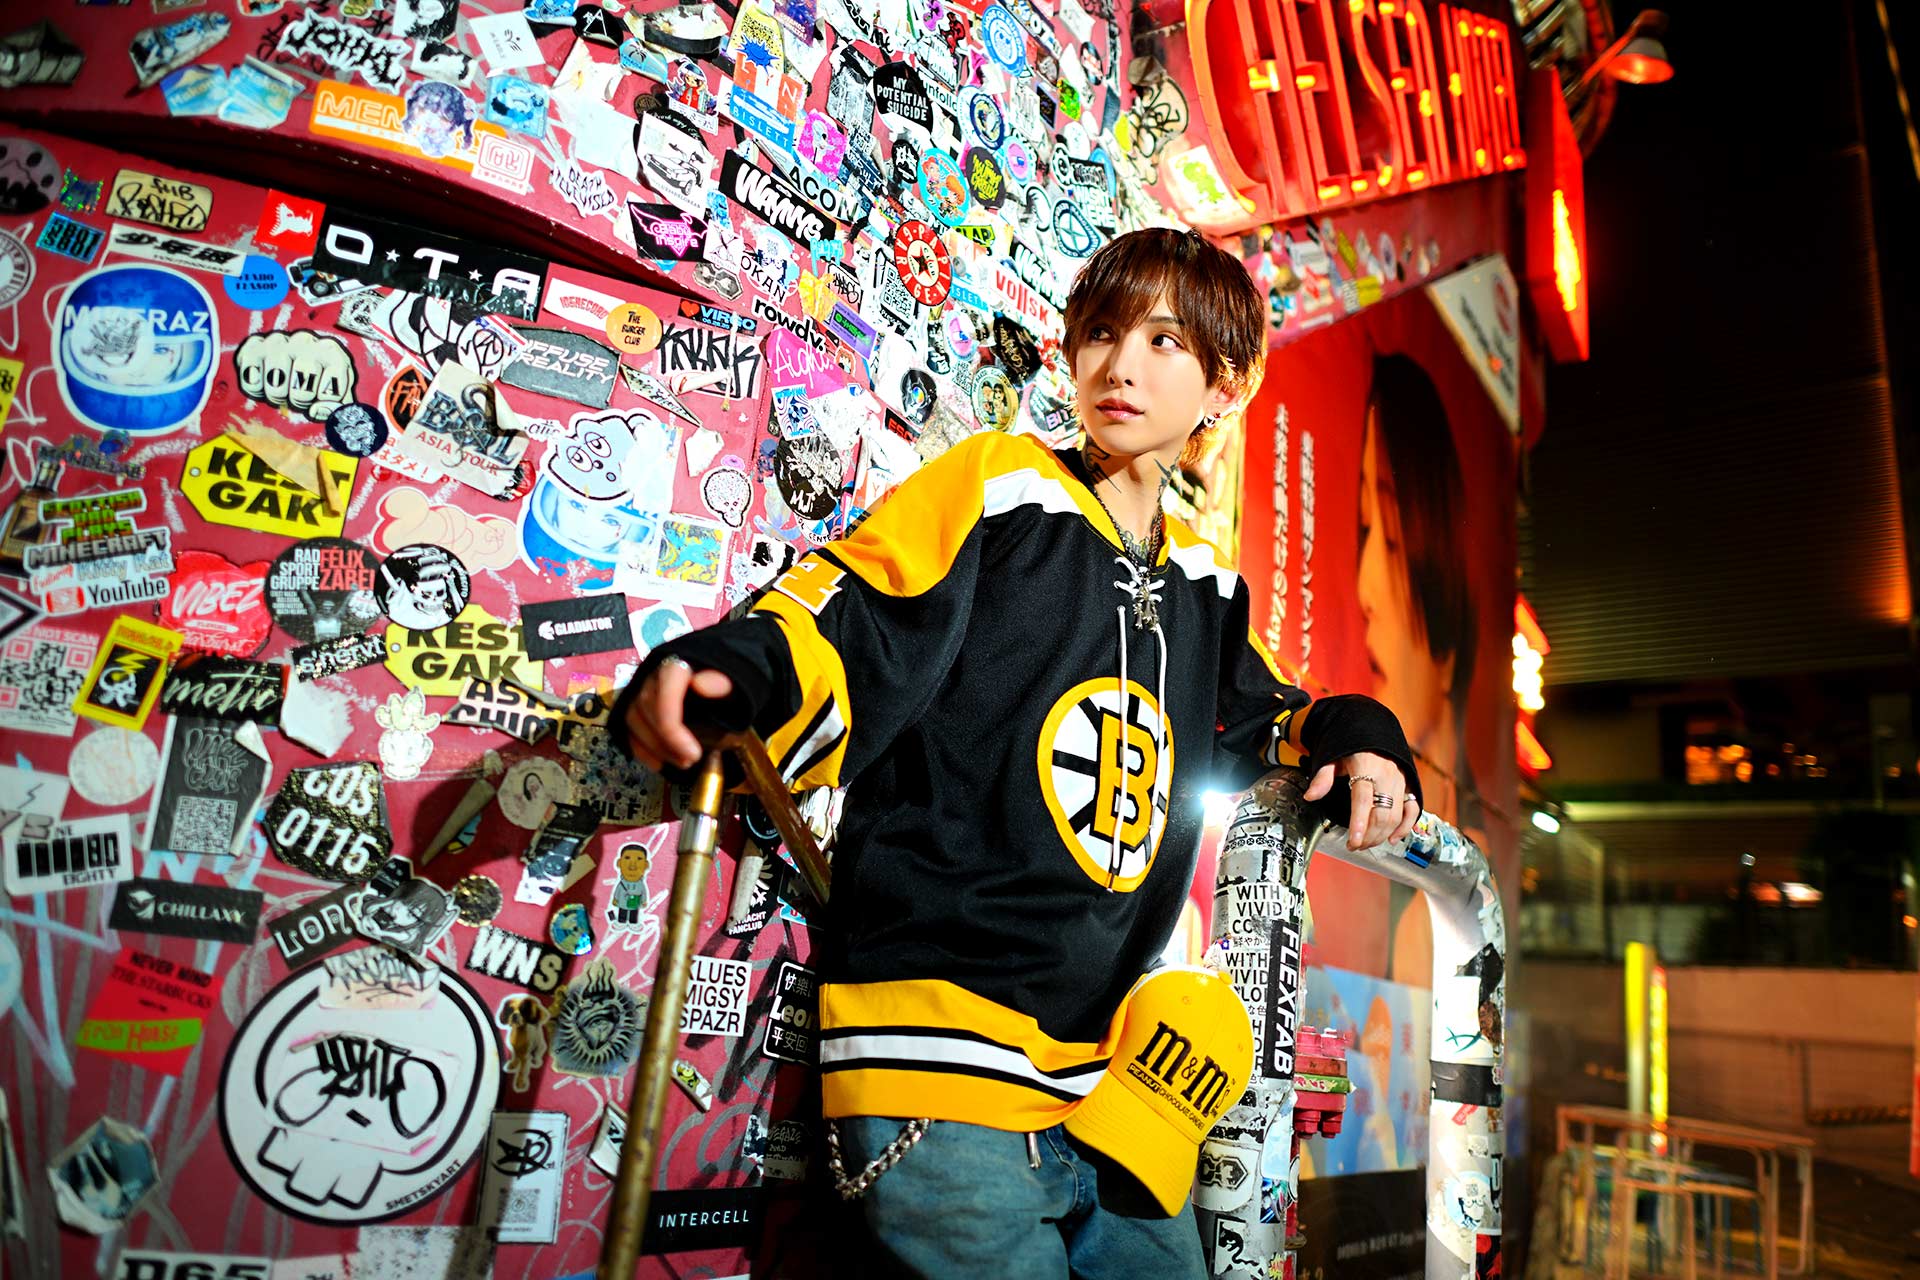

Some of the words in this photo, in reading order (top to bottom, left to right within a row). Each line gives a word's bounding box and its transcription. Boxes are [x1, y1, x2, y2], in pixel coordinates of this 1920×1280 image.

[892, 76, 907, 91] MY
[876, 82, 929, 110] POTENTIAL
[886, 101, 928, 121] SUICIDE
[732, 105, 789, 149] BISLETT
[741, 255, 786, 301] OKAN
[627, 311, 641, 325] THE
[700, 304, 756, 331] VIRGO
[621, 325, 646, 336] BURGER
[624, 335, 641, 346] CLUB
[526, 340, 609, 372] IFFUSE
[416, 431, 451, 455] ASIA
[462, 451, 499, 476] TOUR
[294, 548, 320, 563] RAD
[320, 545, 364, 569] FÉLIX
[279, 562, 320, 577] SPORT
[88, 577, 166, 605] YouTube
[270, 576, 320, 591] GRUPPE
[172, 577, 265, 618] VIBEZ
[554, 616, 613, 637] GLADIATOR
[411, 651, 522, 684] GAK
[275, 807, 378, 874] 0115
[1237, 885, 1280, 901] WITH
[1236, 901, 1282, 917] VIVID
[1226, 951, 1267, 968] WITH
[1230, 970, 1269, 986] IVID
[1274, 925, 1299, 1076] FLEXFAB
[1128, 1063, 1161, 1093] PEANUT
[659, 1210, 750, 1228] INTERCELL
